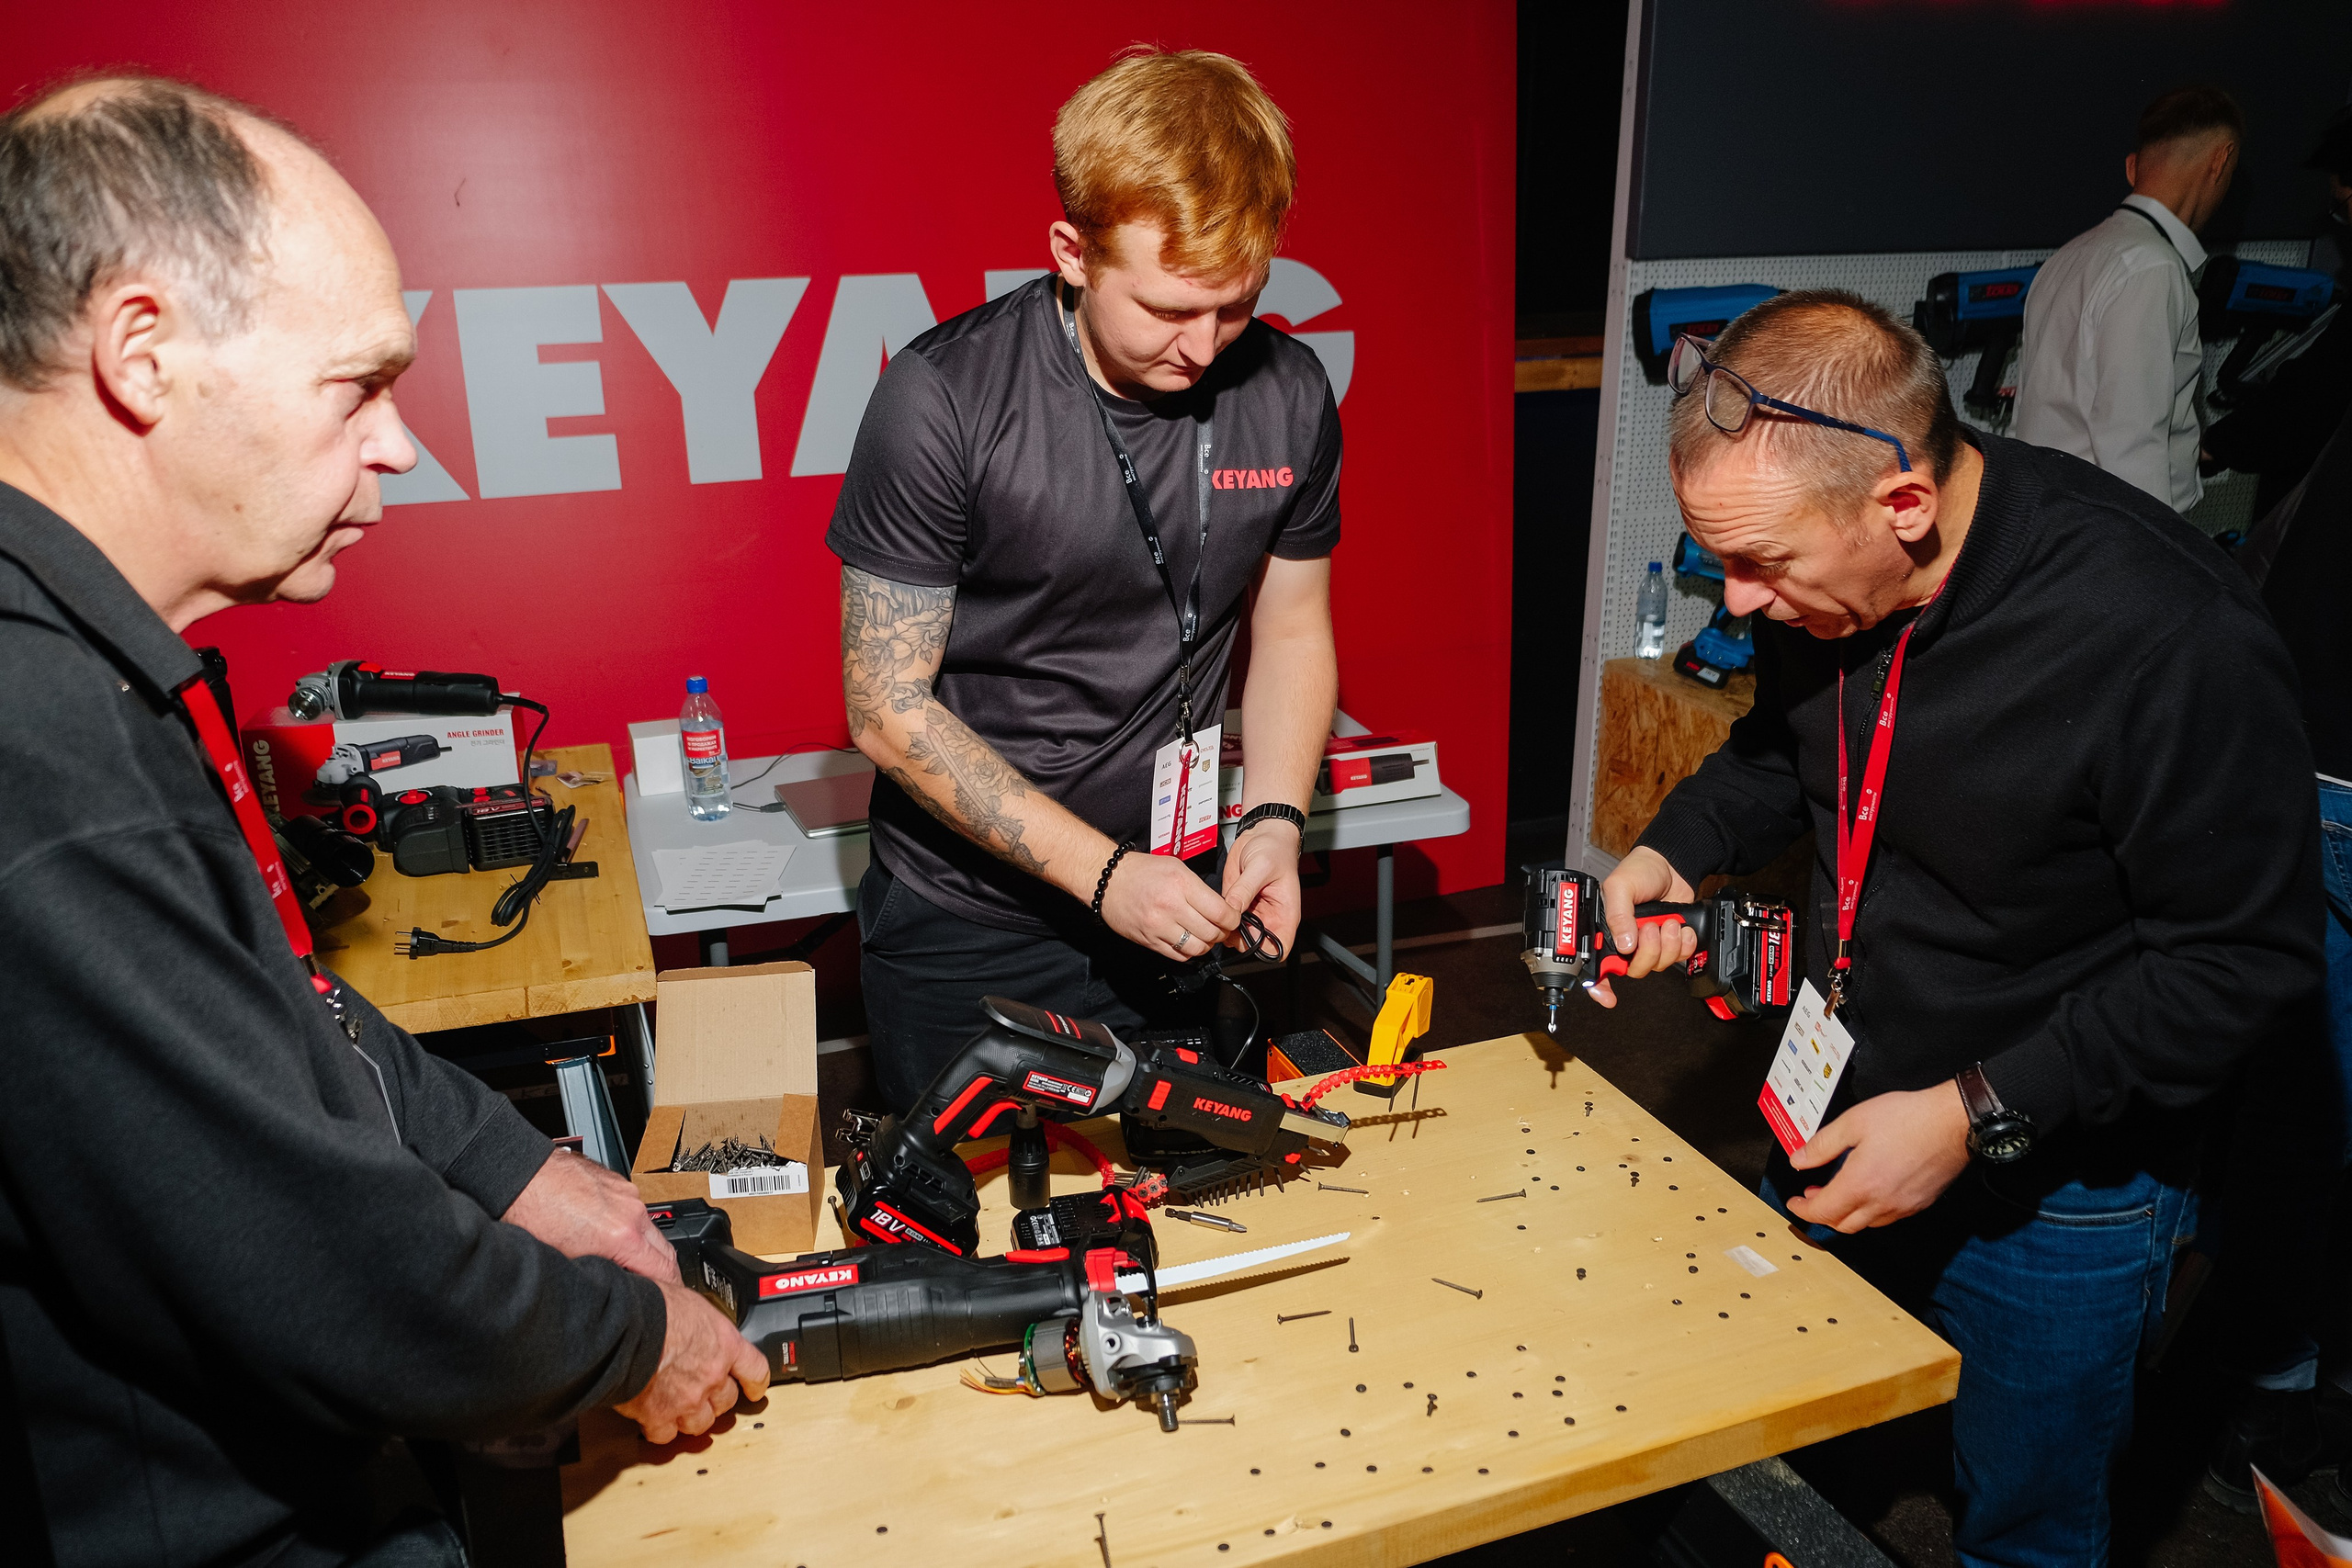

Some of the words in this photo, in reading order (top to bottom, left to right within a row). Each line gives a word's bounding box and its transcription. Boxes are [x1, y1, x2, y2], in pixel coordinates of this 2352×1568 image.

[378, 257, 1355, 506] EYA
[1125, 469, 1133, 484] Все
[1212, 467, 1294, 490] KEYANG
[1879, 711, 1889, 727] Все
[447, 730, 470, 739] ANGLE
[472, 728, 504, 737] GRINDER
[253, 739, 280, 812] EYANG
[1161, 761, 1172, 770] AEG
[1859, 806, 1869, 821] Все
[1842, 897, 1851, 910] Все
[1562, 888, 1574, 944] KEYANG
[1193, 1097, 1252, 1122] KEYANG
[870, 1209, 907, 1233] 18V
[775, 1269, 853, 1290] KEYANG
